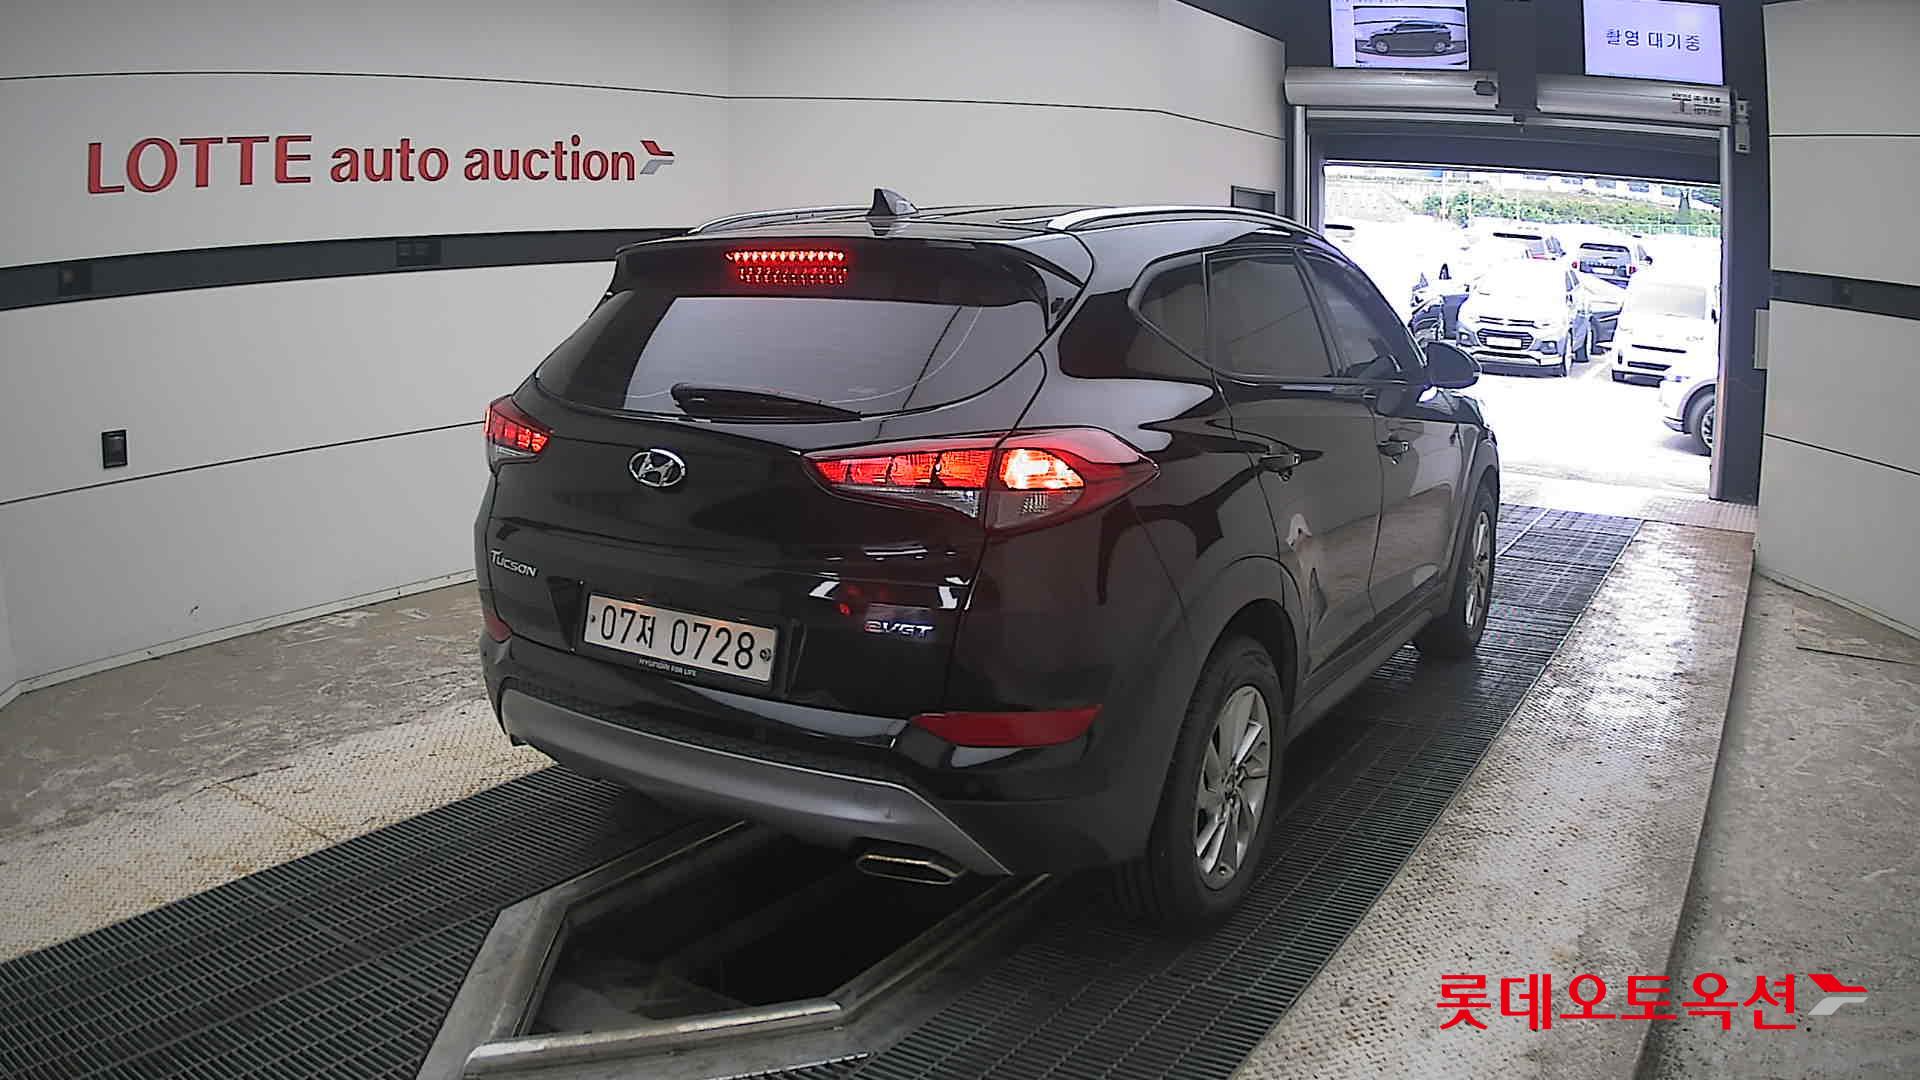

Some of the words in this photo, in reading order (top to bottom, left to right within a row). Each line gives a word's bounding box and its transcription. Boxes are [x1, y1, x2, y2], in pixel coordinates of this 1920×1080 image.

[86, 134, 313, 194] LOTTE
[329, 137, 449, 182] auto
[463, 134, 635, 181] auction
[601, 605, 656, 649] 07저
[670, 619, 756, 671] 0728
